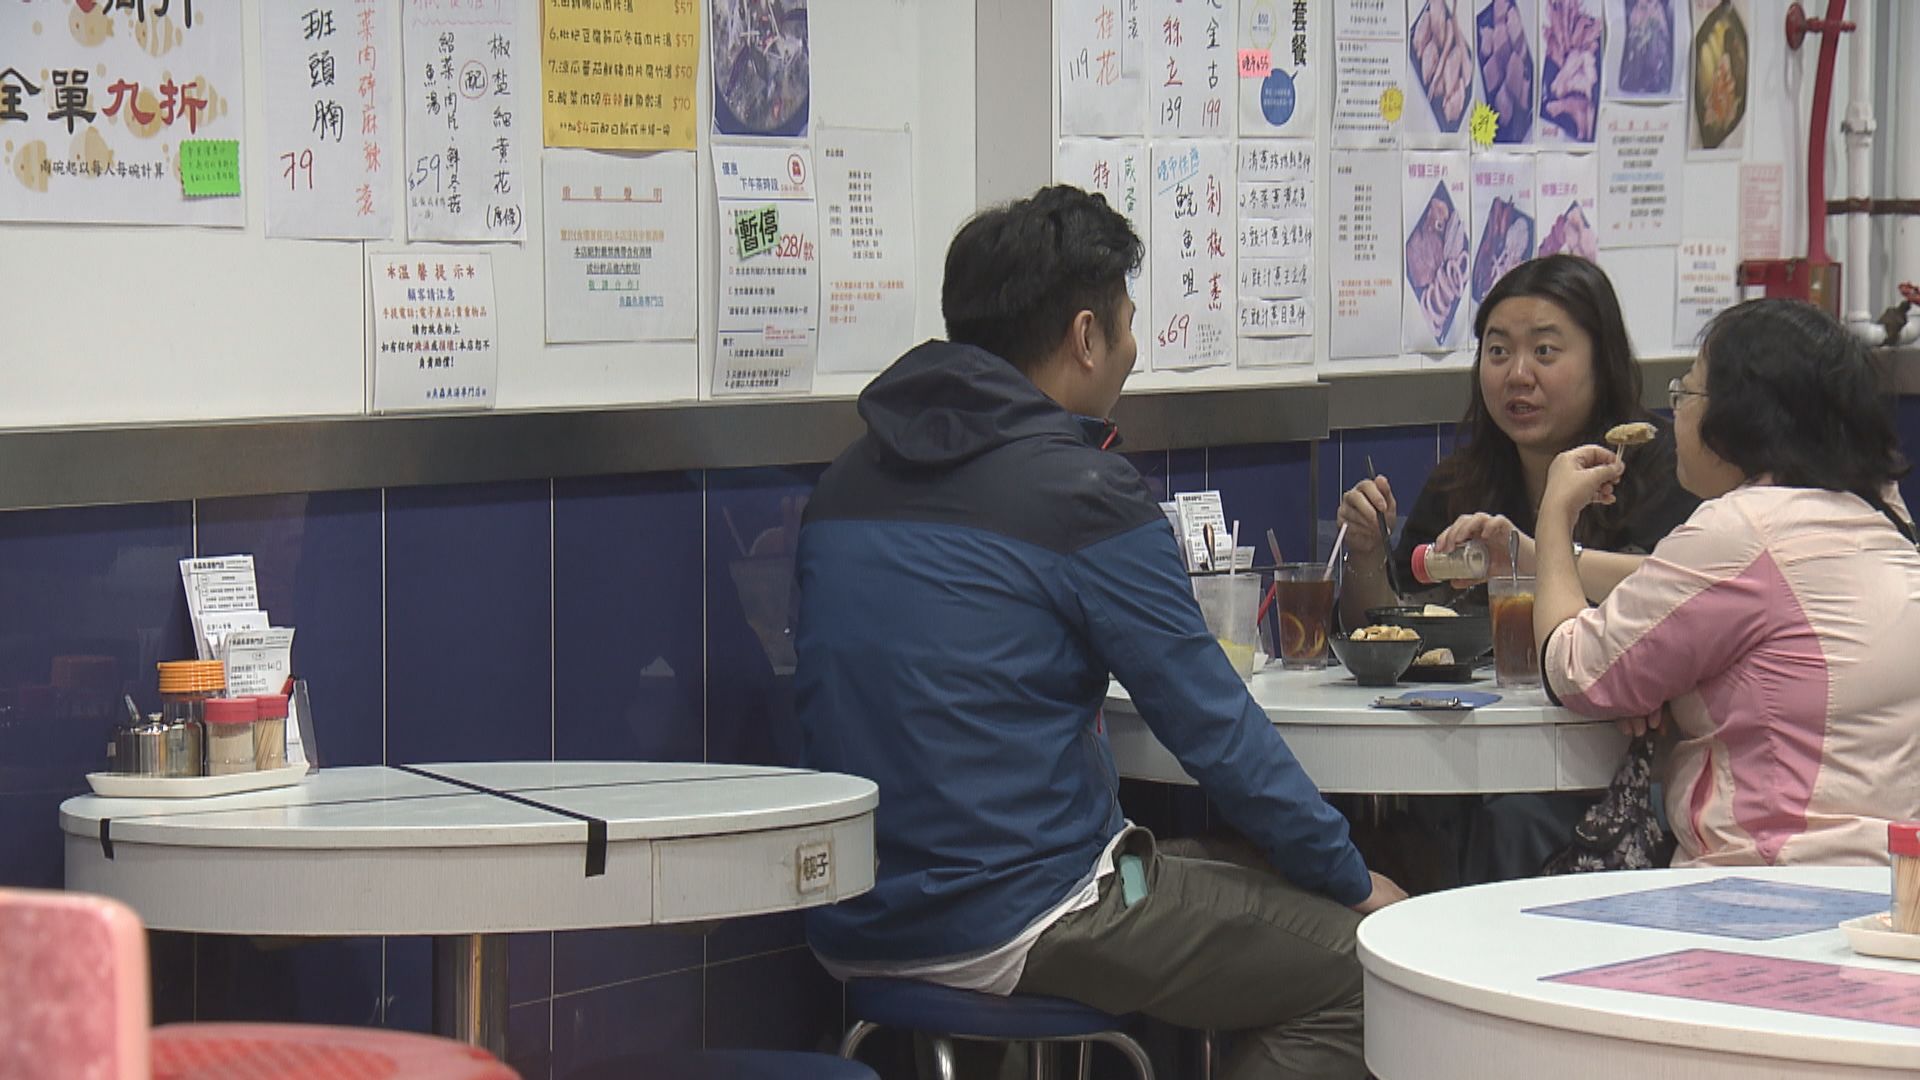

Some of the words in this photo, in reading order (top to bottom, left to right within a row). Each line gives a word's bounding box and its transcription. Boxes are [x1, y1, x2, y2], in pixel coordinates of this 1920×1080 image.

[1069, 48, 1089, 81] 119
[0, 67, 208, 135] 全單九折
[1161, 96, 1182, 128] 139
[1202, 99, 1221, 128] 199
[281, 149, 313, 190] 79
[738, 208, 779, 253] 暫停
